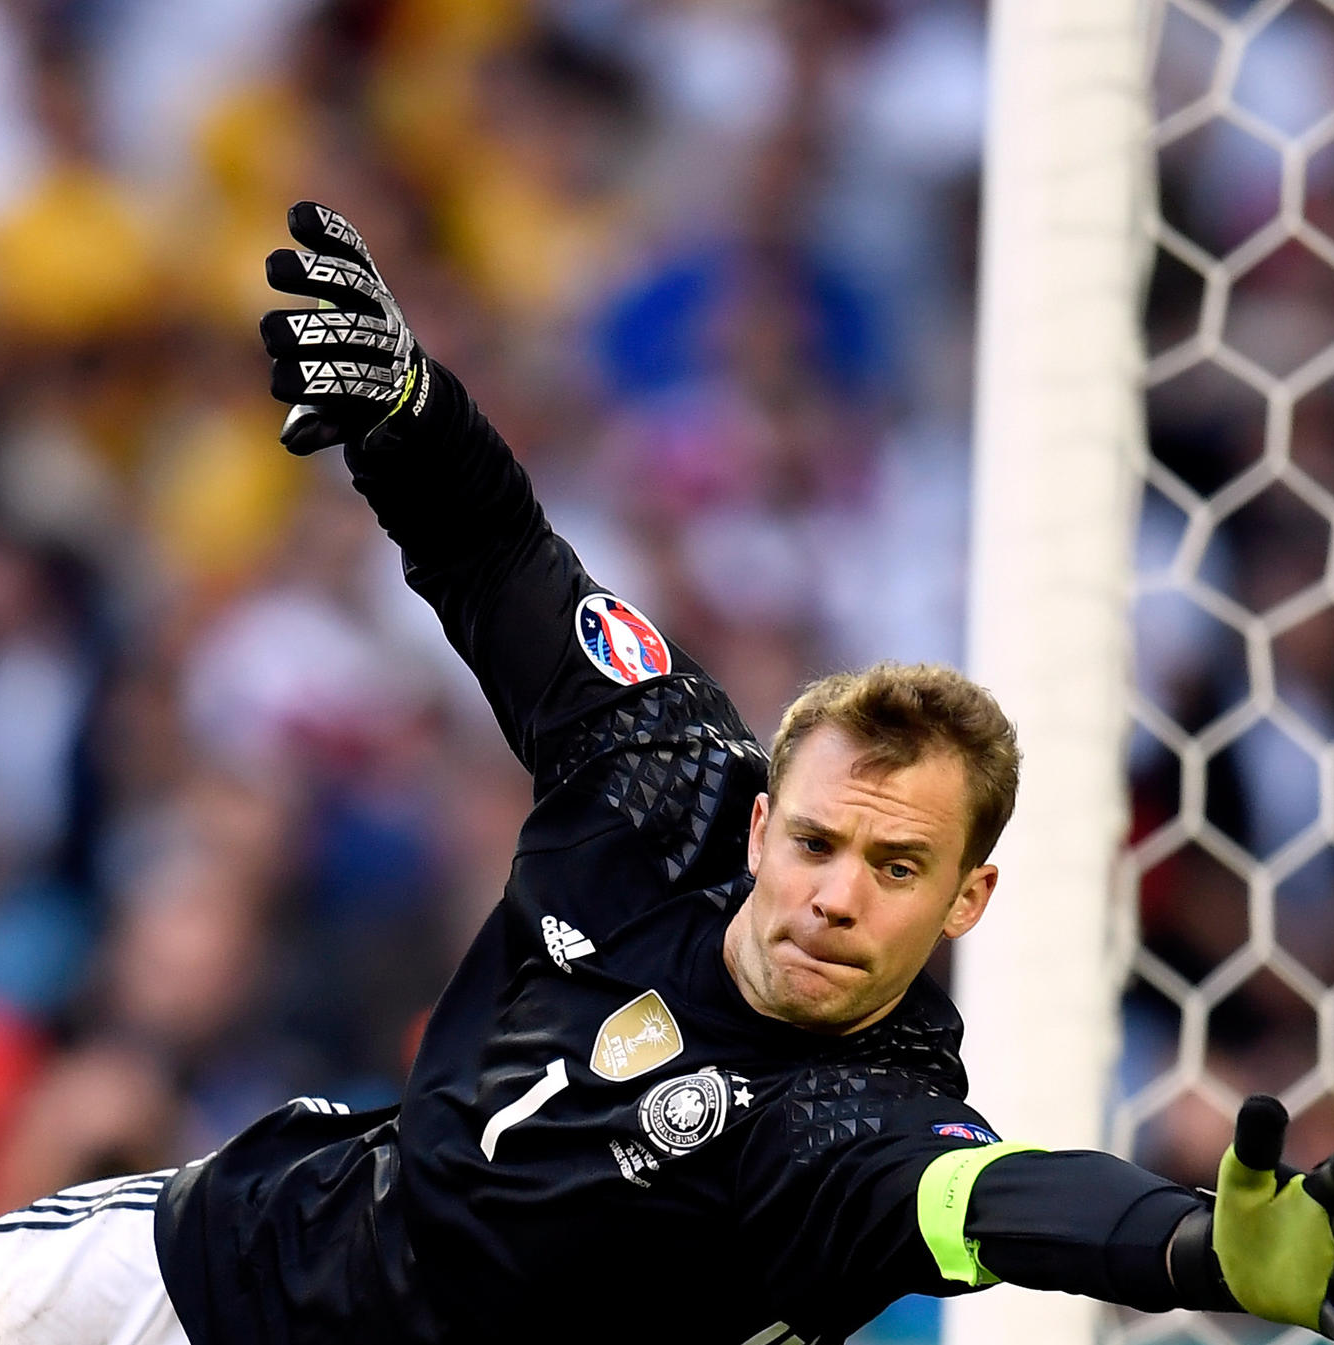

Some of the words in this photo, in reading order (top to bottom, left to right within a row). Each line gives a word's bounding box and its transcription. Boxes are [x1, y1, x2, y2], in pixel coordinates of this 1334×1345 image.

[541, 915, 572, 974] adidas
[610, 1036, 628, 1068] FIFA
[479, 1058, 569, 1163] 1
[653, 1100, 699, 1143] FUSSBALL-BUND
